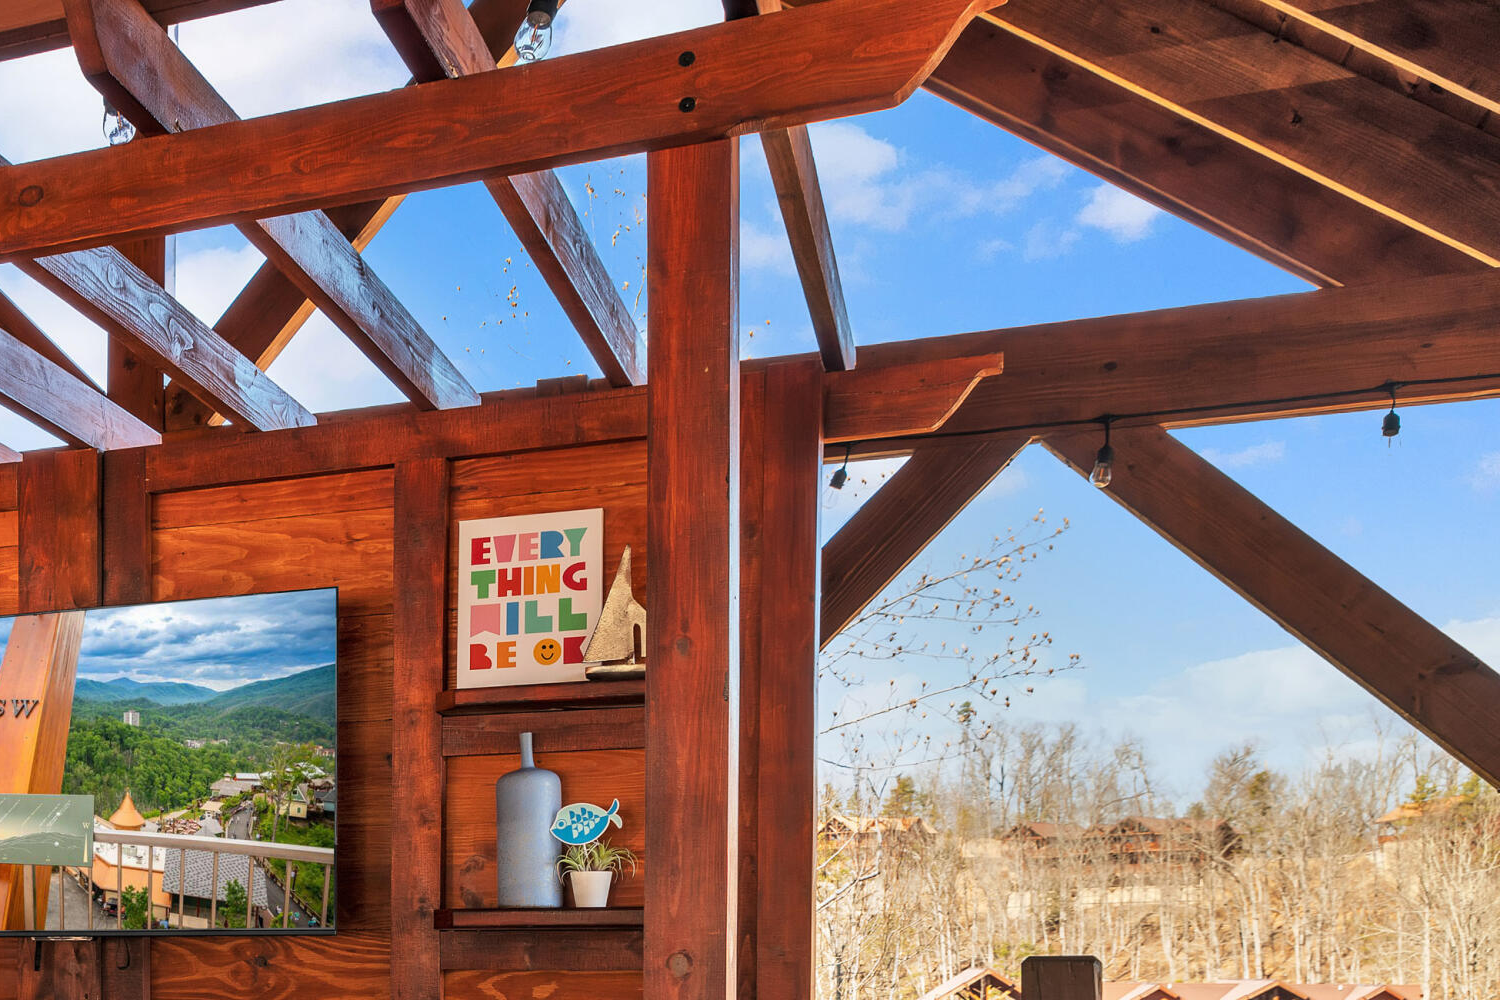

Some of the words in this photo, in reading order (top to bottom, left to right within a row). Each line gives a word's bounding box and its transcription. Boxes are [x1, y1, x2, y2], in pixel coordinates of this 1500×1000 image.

[471, 528, 588, 565] EVERY
[471, 562, 588, 599] THING
[470, 598, 587, 637] WILL
[470, 641, 517, 670] BE
